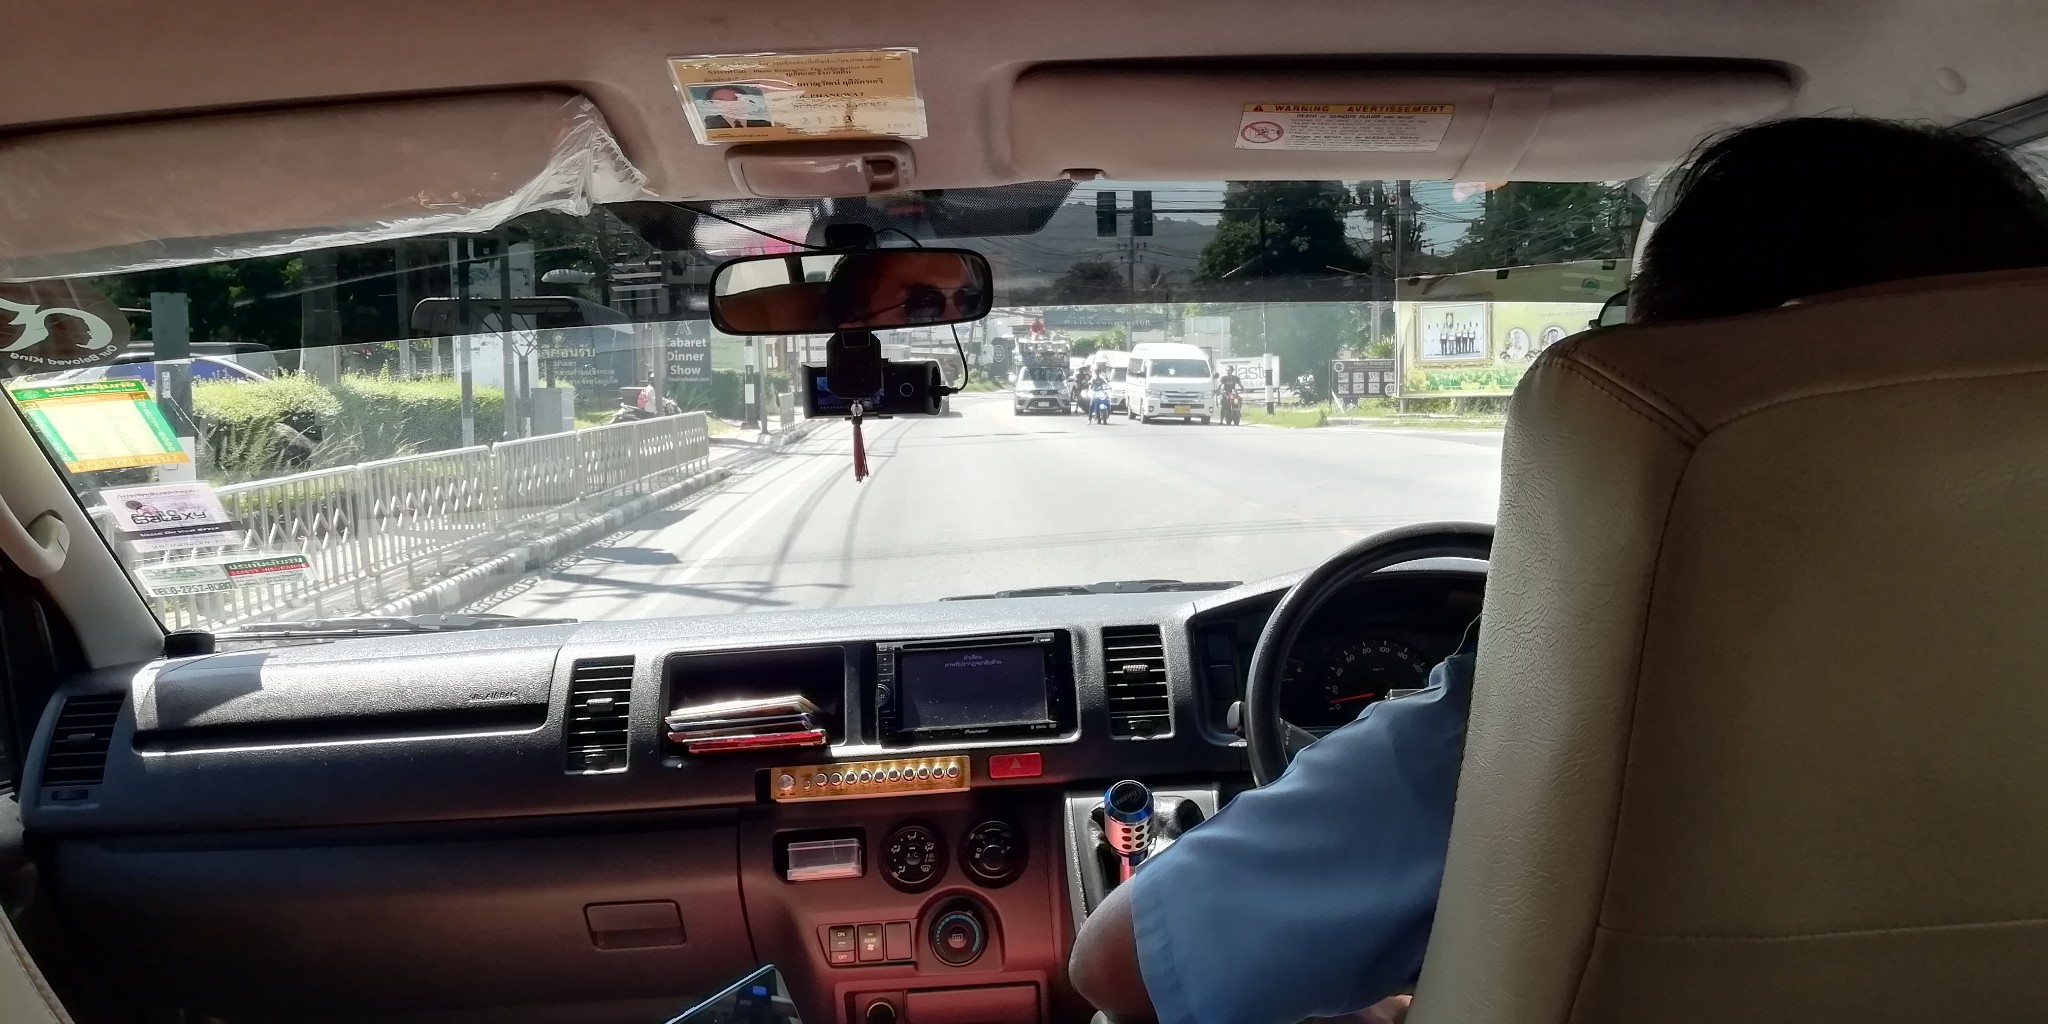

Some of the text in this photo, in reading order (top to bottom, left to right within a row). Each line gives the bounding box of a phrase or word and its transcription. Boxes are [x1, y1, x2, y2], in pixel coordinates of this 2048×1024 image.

[1347, 105, 1446, 113] AVERTISSEMENT
[667, 350, 705, 361] Dinner
[670, 365, 701, 375] Show
